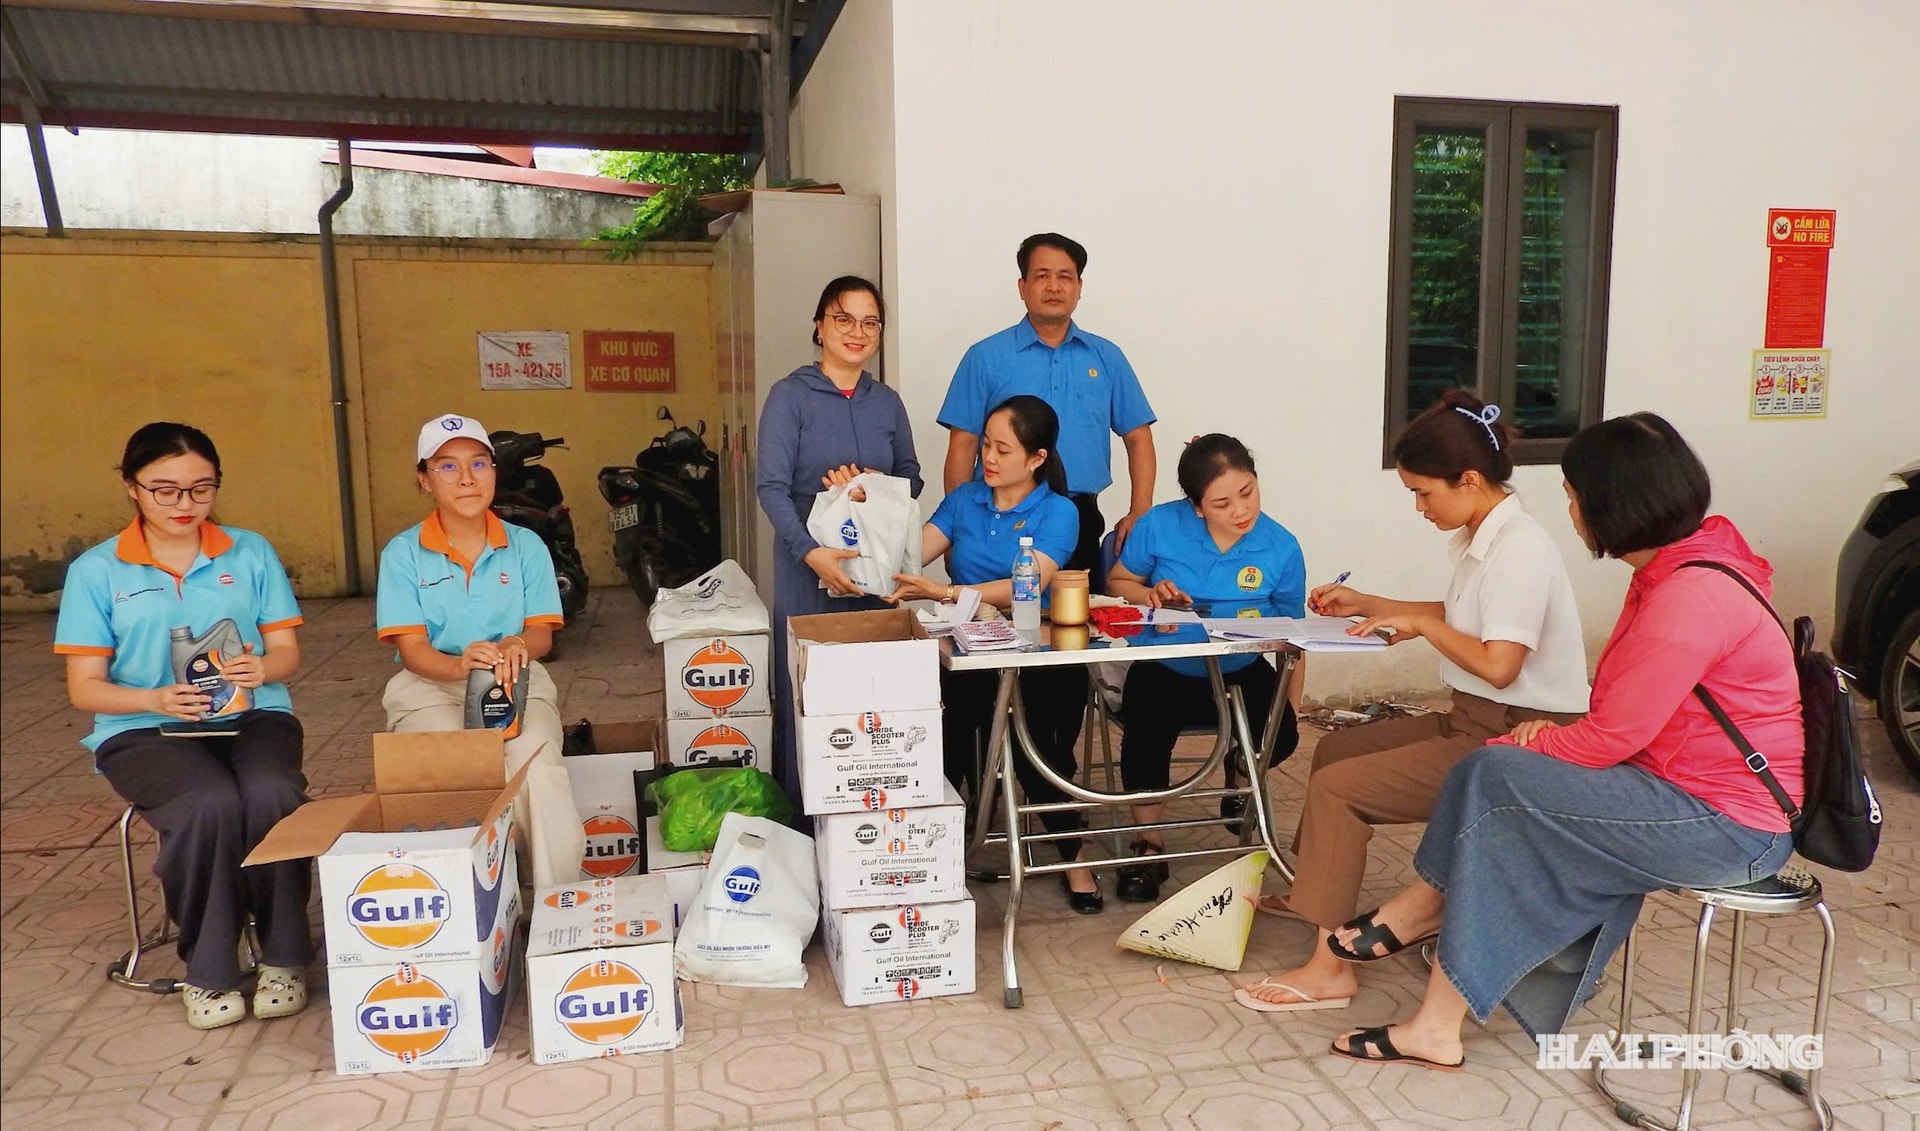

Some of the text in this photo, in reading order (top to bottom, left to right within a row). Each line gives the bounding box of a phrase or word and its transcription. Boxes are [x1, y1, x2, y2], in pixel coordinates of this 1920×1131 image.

[1794, 216, 1830, 229] CẤM LỬA
[1793, 232, 1830, 243] NO FIRE
[516, 341, 533, 357] XE
[600, 341, 658, 360] KHU VỰC
[488, 363, 511, 378] 15A
[522, 362, 563, 378] 421.75
[590, 366, 670, 384] XE CƠ QUAN
[685, 669, 750, 687] Gulf
[829, 735, 854, 743] Gulf
[871, 732, 905, 740] SCOOTER
[856, 763, 868, 771] Oil
[869, 761, 918, 770] International
[891, 856, 937, 864] International
[726, 877, 760, 893] Gulf
[561, 891, 575, 908] Gulf
[351, 896, 445, 922] Gulf
[905, 952, 951, 961] International
[559, 989, 648, 1019] Gulf
[360, 1004, 452, 1031] Gulf
[637, 1041, 671, 1050] International
